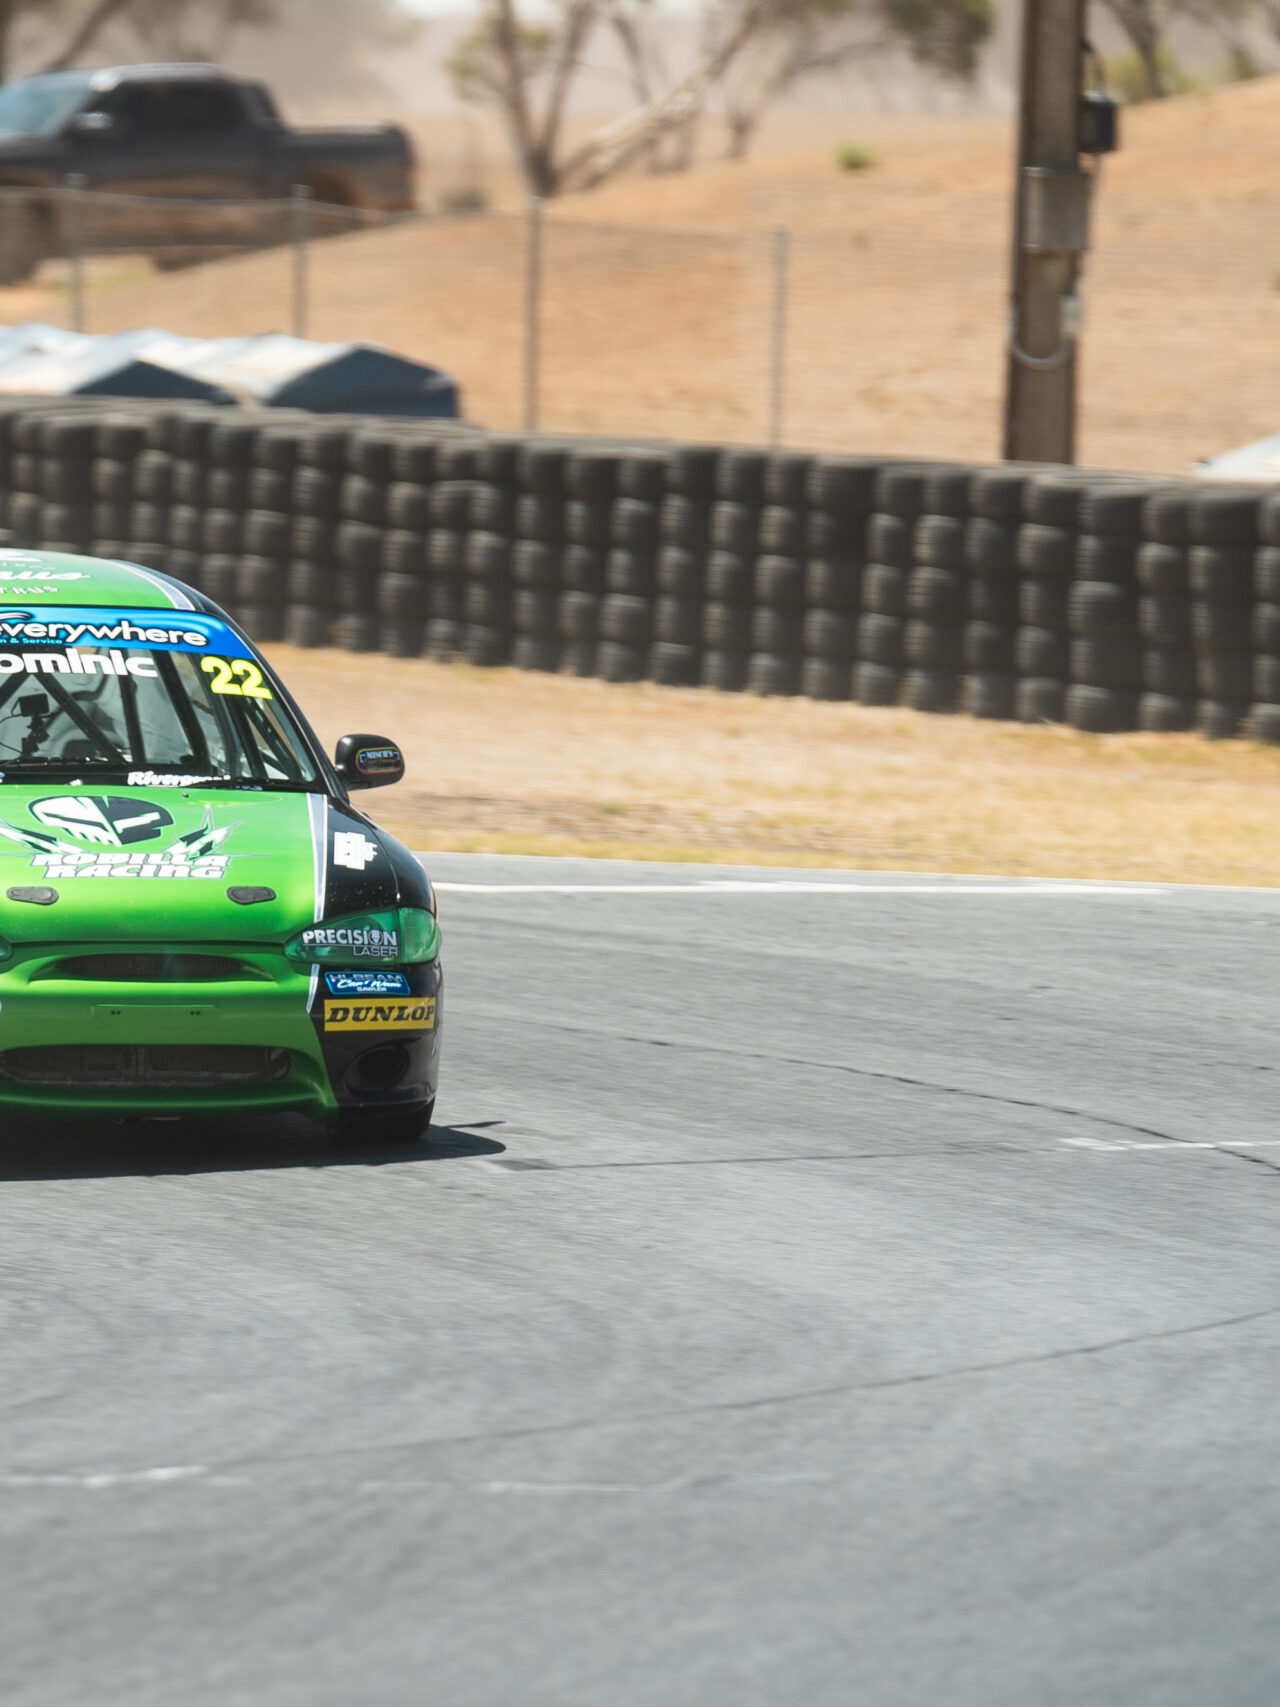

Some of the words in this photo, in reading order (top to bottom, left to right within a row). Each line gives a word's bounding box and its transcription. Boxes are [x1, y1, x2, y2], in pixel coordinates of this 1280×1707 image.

[10, 637, 20, 645] &
[22, 637, 64, 645] Service
[200, 656, 273, 700] 22
[31, 852, 231, 867] ROBILLA
[302, 929, 398, 946] PRECISION
[353, 945, 398, 957] LASER
[326, 1004, 435, 1023] DUNLOP
